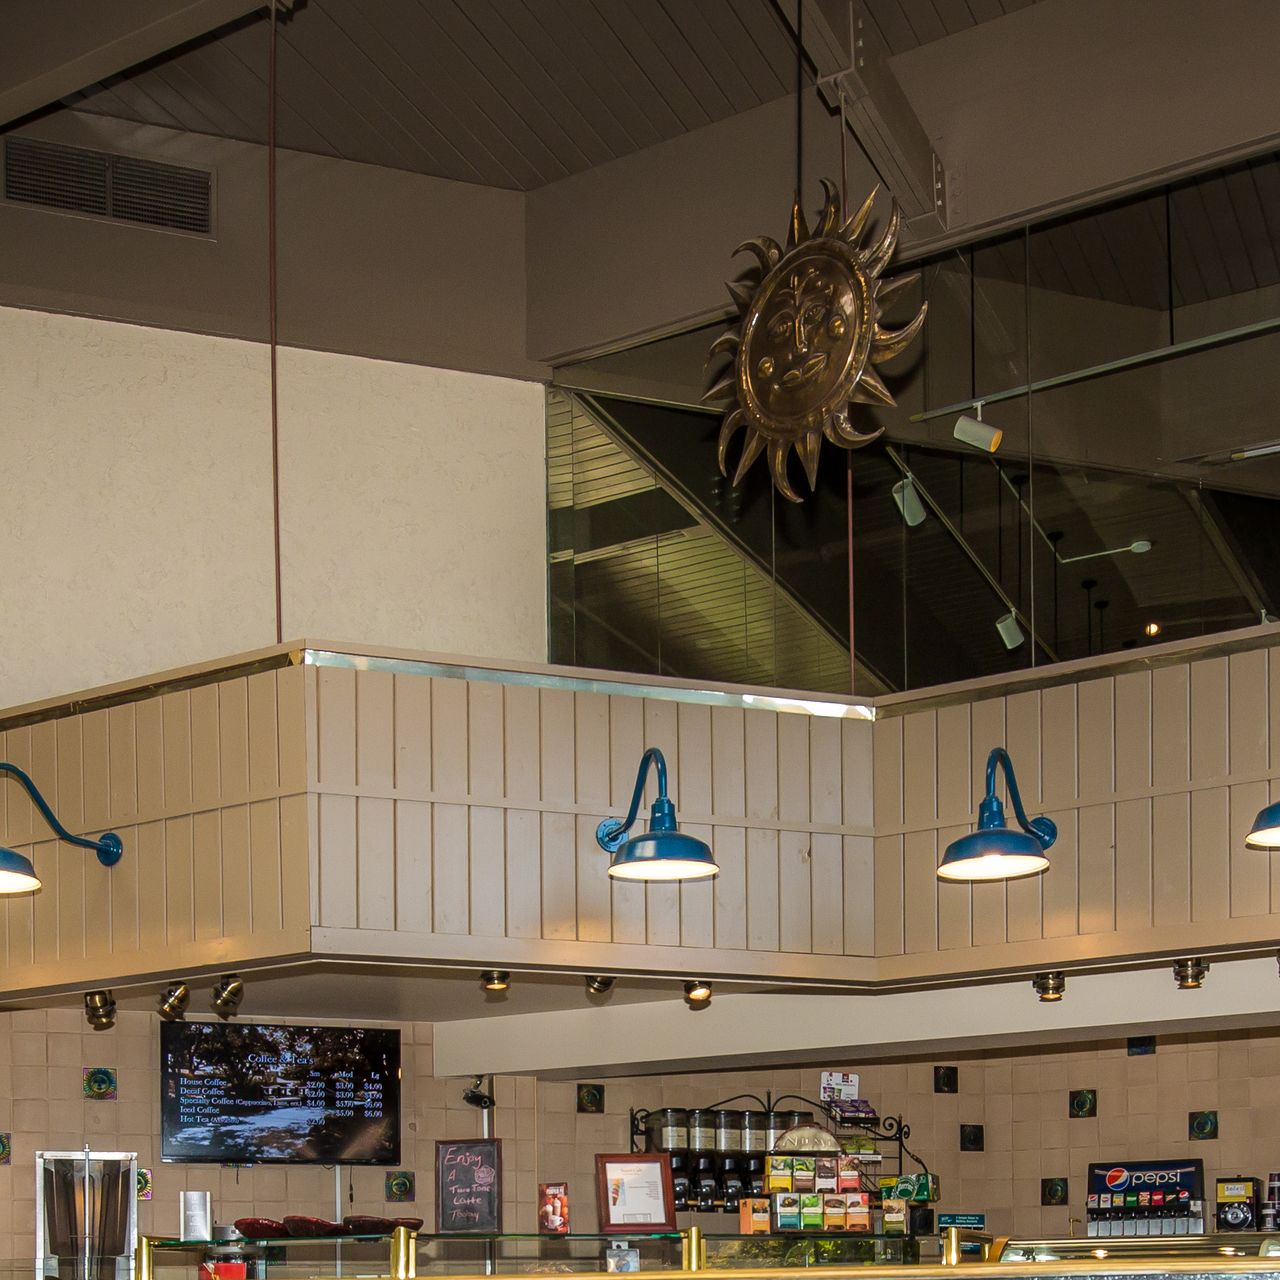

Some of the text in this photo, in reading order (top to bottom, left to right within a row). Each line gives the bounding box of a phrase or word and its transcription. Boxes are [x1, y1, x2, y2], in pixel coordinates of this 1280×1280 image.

[248, 1053, 277, 1064] Coffee
[180, 1077, 203, 1087] House
[204, 1079, 227, 1087] Coffee
[180, 1087, 201, 1096] Decaf
[202, 1087, 225, 1096] Coffee
[180, 1096, 210, 1106] Specialty
[211, 1097, 234, 1106] Coffee
[180, 1105, 196, 1114] Iced
[197, 1106, 220, 1115] Coffee
[180, 1114, 195, 1124] Hot
[196, 1115, 210, 1124] Tea
[444, 1147, 482, 1169] Enjoy
[447, 1169, 456, 1181] A
[1132, 1169, 1181, 1187] pepsi
